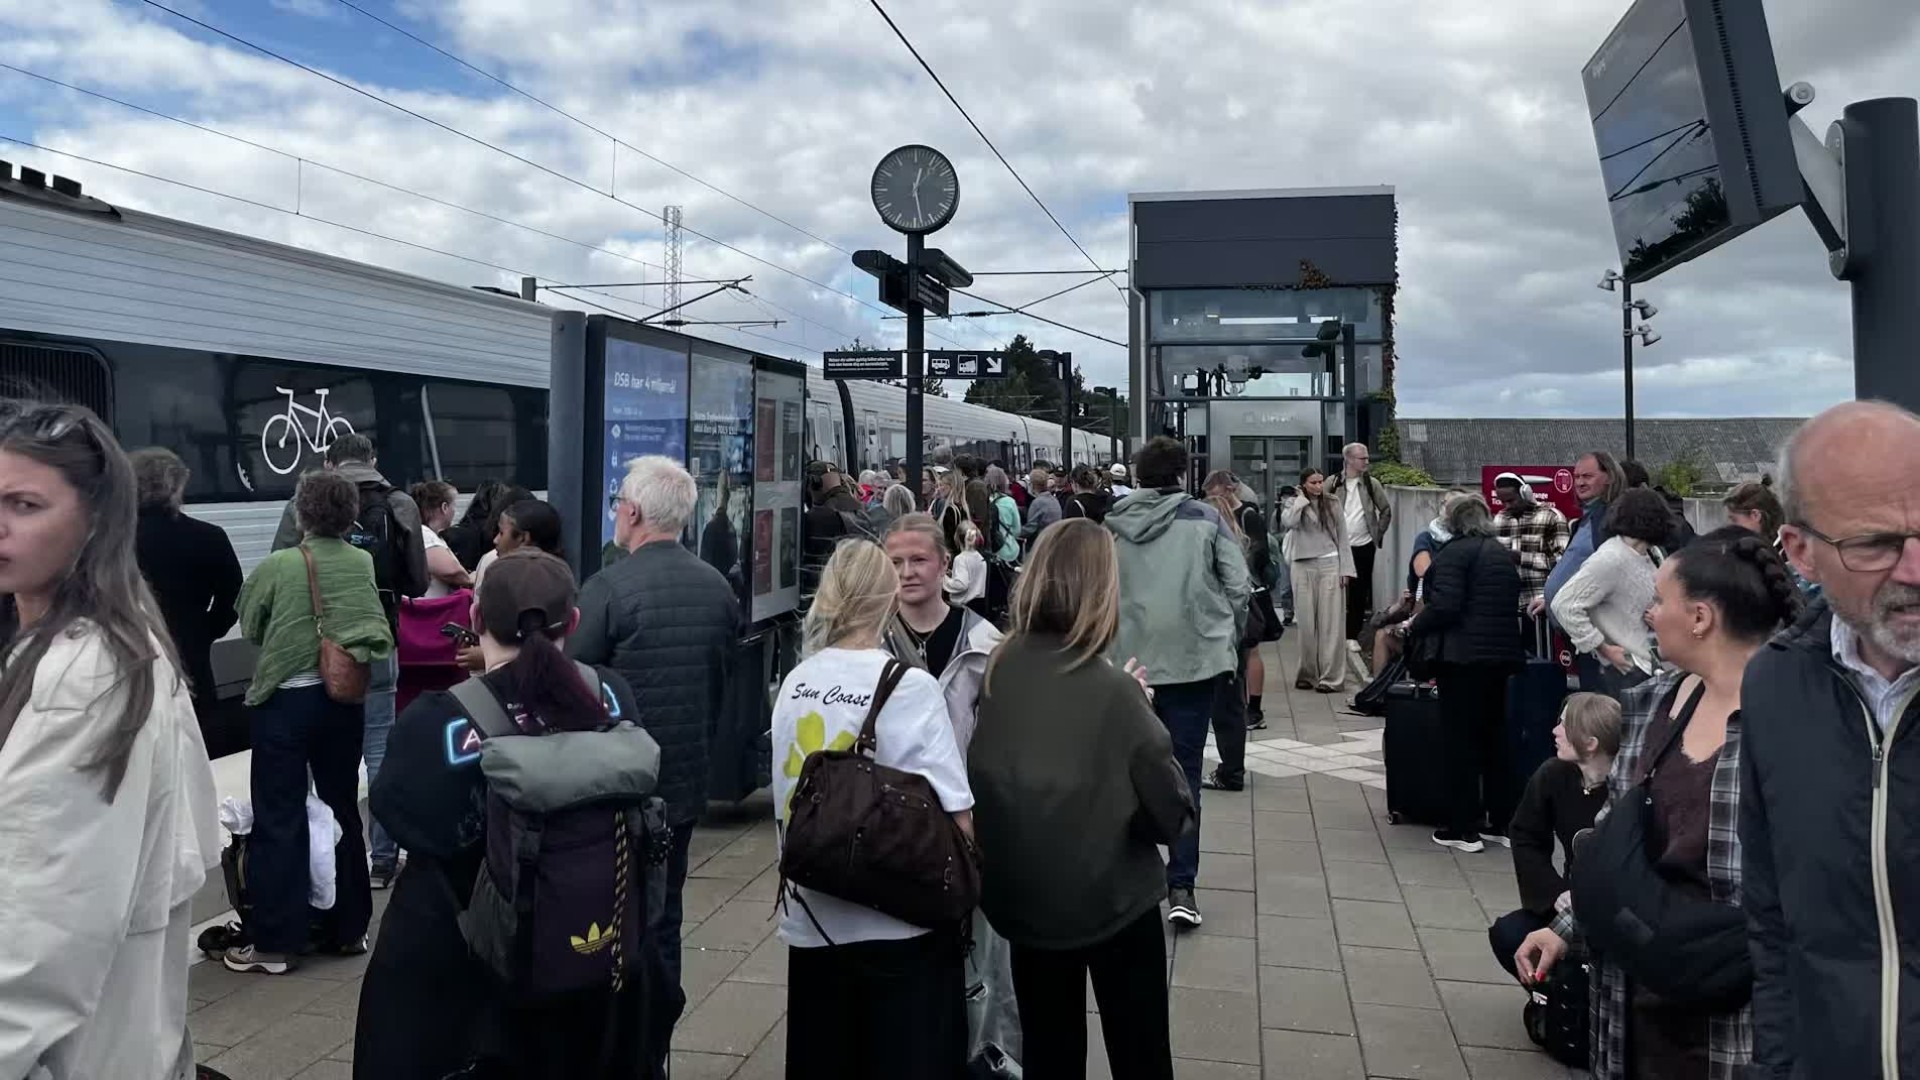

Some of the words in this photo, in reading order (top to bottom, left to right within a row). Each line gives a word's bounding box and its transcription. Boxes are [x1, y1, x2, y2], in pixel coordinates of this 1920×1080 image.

[614, 371, 630, 387] DSB
[1078, 407, 1085, 417] 2
[791, 683, 820, 700] Sun
[823, 685, 871, 706] Coast
